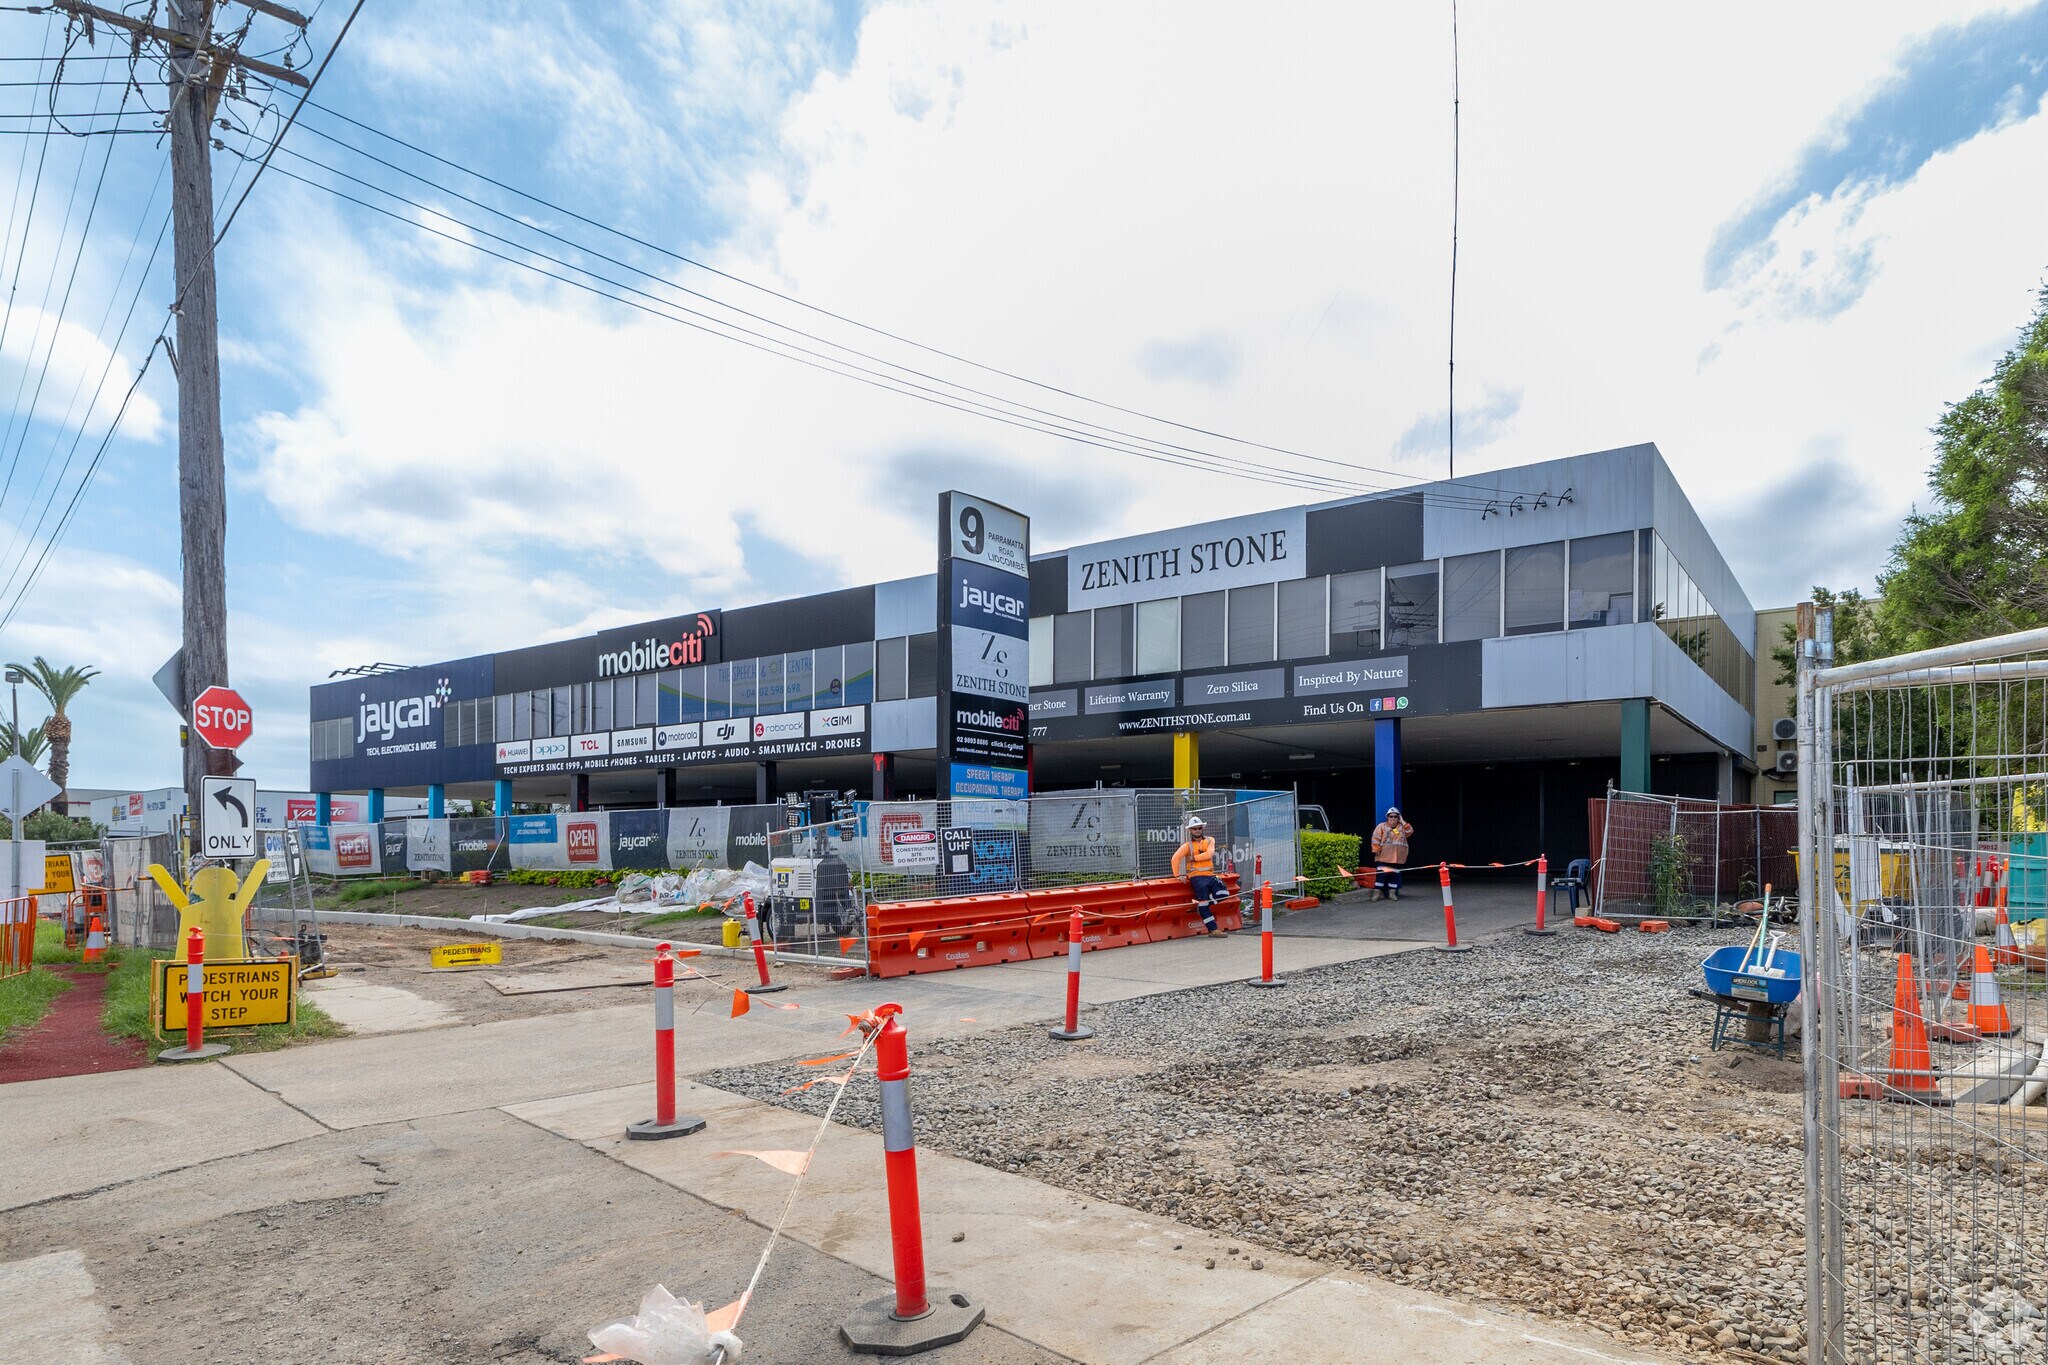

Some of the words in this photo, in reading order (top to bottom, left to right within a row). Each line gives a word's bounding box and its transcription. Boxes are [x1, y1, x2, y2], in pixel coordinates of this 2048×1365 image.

[959, 506, 985, 556] 9
[988, 532, 1025, 551] PARRAMATTA
[998, 546, 1015, 558] ROAD
[988, 552, 1026, 573] LIDCOMBE
[1081, 547, 1181, 591] ZENITH
[1190, 530, 1287, 574] STONE
[959, 578, 1025, 617] jaycar
[598, 629, 703, 678] mobileciti
[956, 674, 997, 692] ZENITH
[998, 680, 1027, 699] STONE
[1298, 671, 1343, 689] Inspired
[1346, 671, 1361, 686] By
[1363, 669, 1404, 681] Nature
[1207, 684, 1230, 695] Zero
[1231, 681, 1259, 693] Silica
[1028, 703, 1042, 711] ner
[1043, 700, 1067, 710] Stone
[1089, 694, 1126, 706] Lifetime
[1127, 690, 1171, 703] Warranty
[1303, 704, 1327, 716] Find
[1330, 702, 1345, 714] Us
[1346, 701, 1365, 713] On
[197, 704, 250, 731] STOP
[357, 692, 437, 744] jaycar
[822, 715, 852, 728] XGIMI
[956, 709, 1020, 731] mobileciti
[1118, 712, 1251, 730] www.ZENITHSTONE.com.au
[765, 721, 804, 733] roborock
[616, 736, 648, 748] SAMSUNG
[667, 729, 698, 742] motorola
[366, 747, 381, 757] TECH,
[381, 742, 415, 755] ELECTRONICS
[415, 742, 420, 751] &
[420, 740, 437, 751] MORE
[507, 748, 529, 757] HUAWEI
[580, 739, 599, 751] TCL
[503, 766, 518, 775] TECH
[519, 764, 544, 774] EXPERTS
[545, 762, 564, 772] SINCE
[565, 760, 583, 771] 1999,
[585, 759, 609, 769] MOBILE
[610, 756, 637, 767] PHONES
[645, 751, 675, 764] TABLETS
[683, 750, 717, 761] LAPTOPS
[725, 747, 750, 758] AUDIO
[758, 740, 817, 755] SMARTWATCH
[825, 738, 862, 750] DRONES
[966, 769, 990, 780] SPEECH
[991, 771, 1016, 783] THERAPY
[955, 782, 1000, 795] OCCUPATIONAL
[1001, 786, 1025, 797] THERAPY
[208, 835, 252, 850] ONLY
[570, 829, 595, 848] OPEN
[618, 833, 651, 851] jaycar
[900, 833, 931, 842] DANGER
[944, 830, 972, 841] CALL
[339, 838, 369, 854] OPEN
[948, 841, 970, 852] UHF
[1046, 844, 1087, 857] ZENITH
[1089, 844, 1122, 858] STONE
[45, 860, 69, 869] TRIANS
[45, 881, 57, 889] TEP
[442, 946, 492, 956] PEDESTRIANS
[945, 951, 970, 961] Coates
[179, 970, 281, 986] PDESTRIANS
[180, 990, 231, 1004] WTCH
[240, 988, 279, 1001] YOUR
[211, 1007, 248, 1020] STEP
